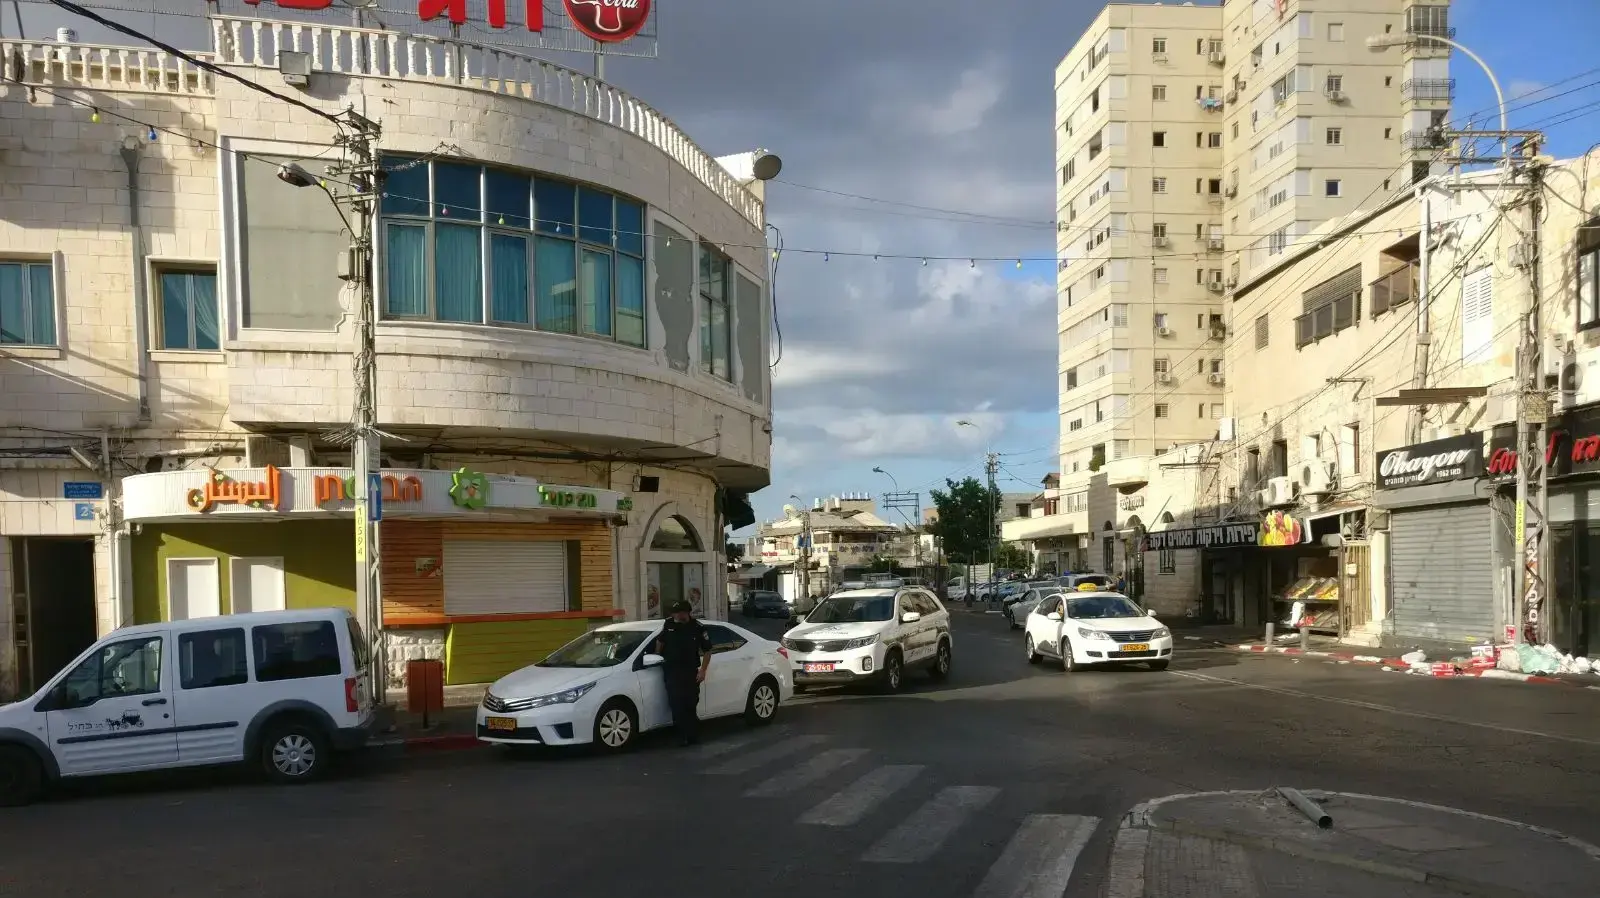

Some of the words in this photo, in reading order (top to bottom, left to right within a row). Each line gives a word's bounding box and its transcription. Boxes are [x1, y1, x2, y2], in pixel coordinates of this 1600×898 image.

[1380, 449, 1472, 480] Ohayon
[81, 506, 89, 517] 2
[1167, 530, 1194, 547] האחים
[1196, 527, 1224, 548] וירקות
[1226, 525, 1256, 543] פירות
